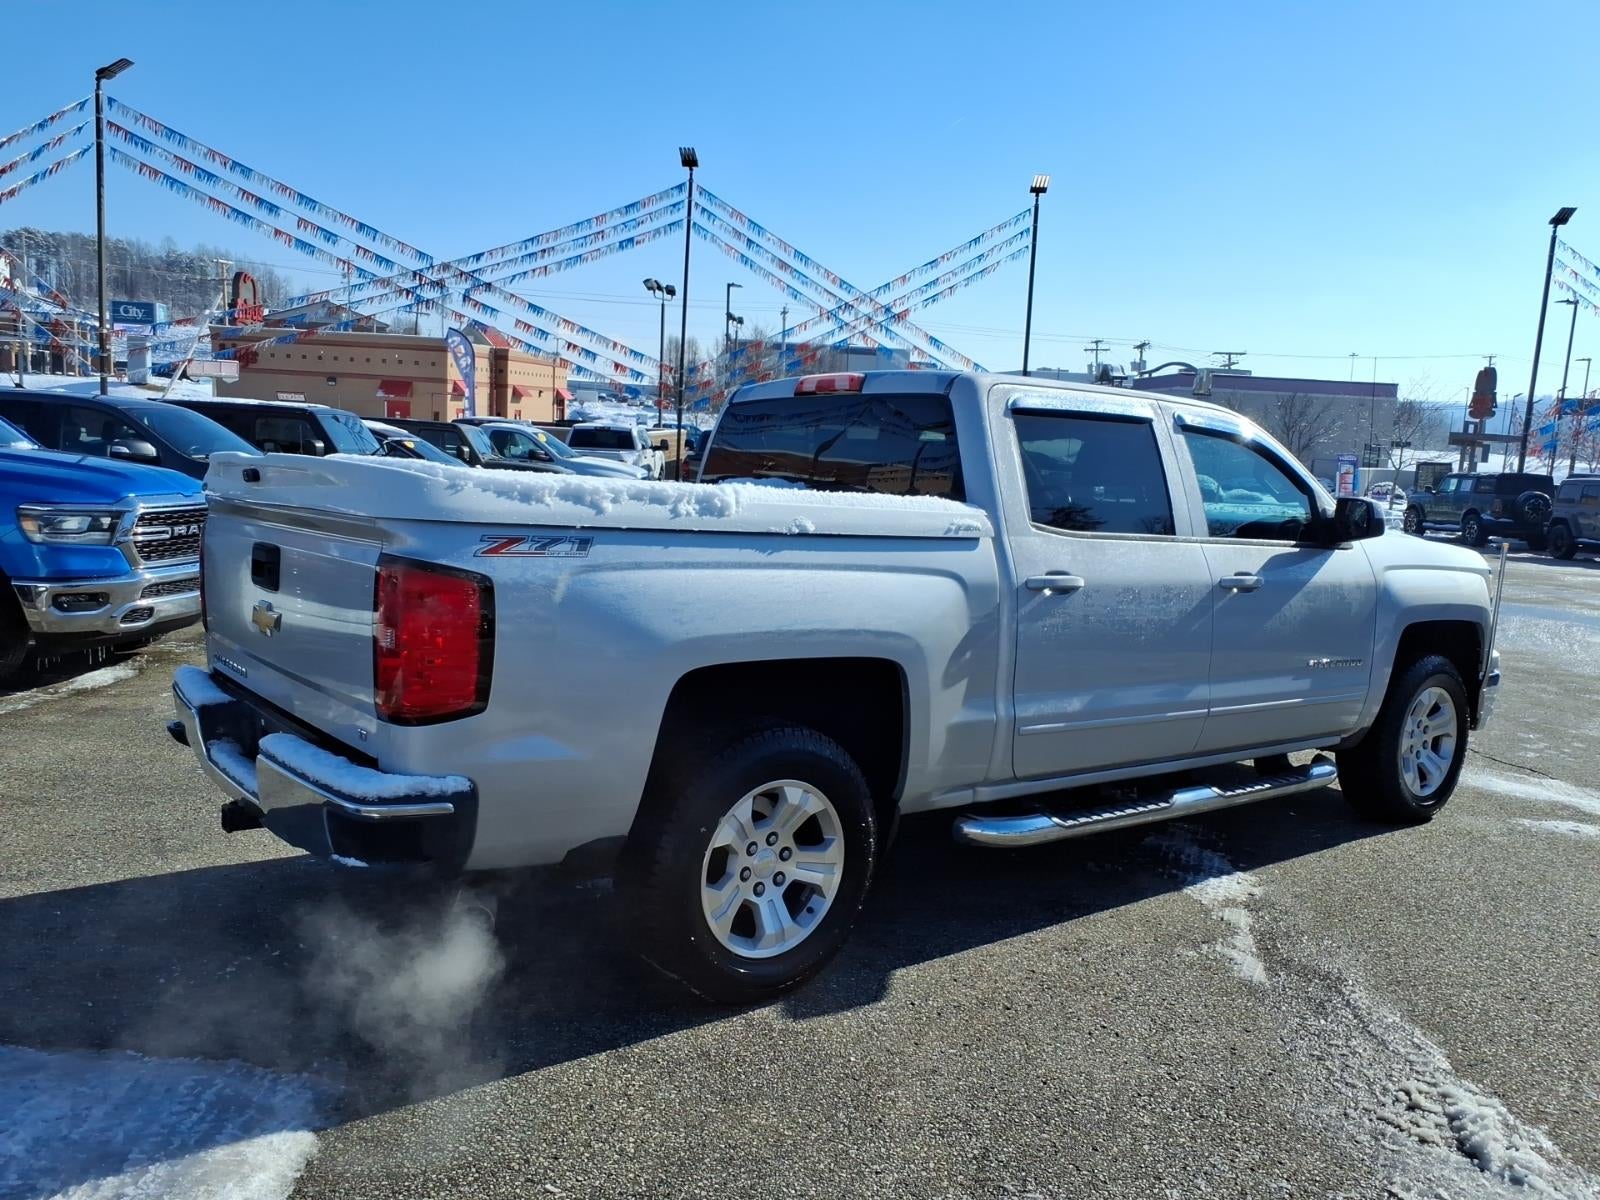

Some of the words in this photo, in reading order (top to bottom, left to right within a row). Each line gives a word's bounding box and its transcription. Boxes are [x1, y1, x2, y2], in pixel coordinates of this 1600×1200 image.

[120, 304, 145, 320] City
[173, 525, 201, 537] RA
[473, 534, 596, 558] Z71
